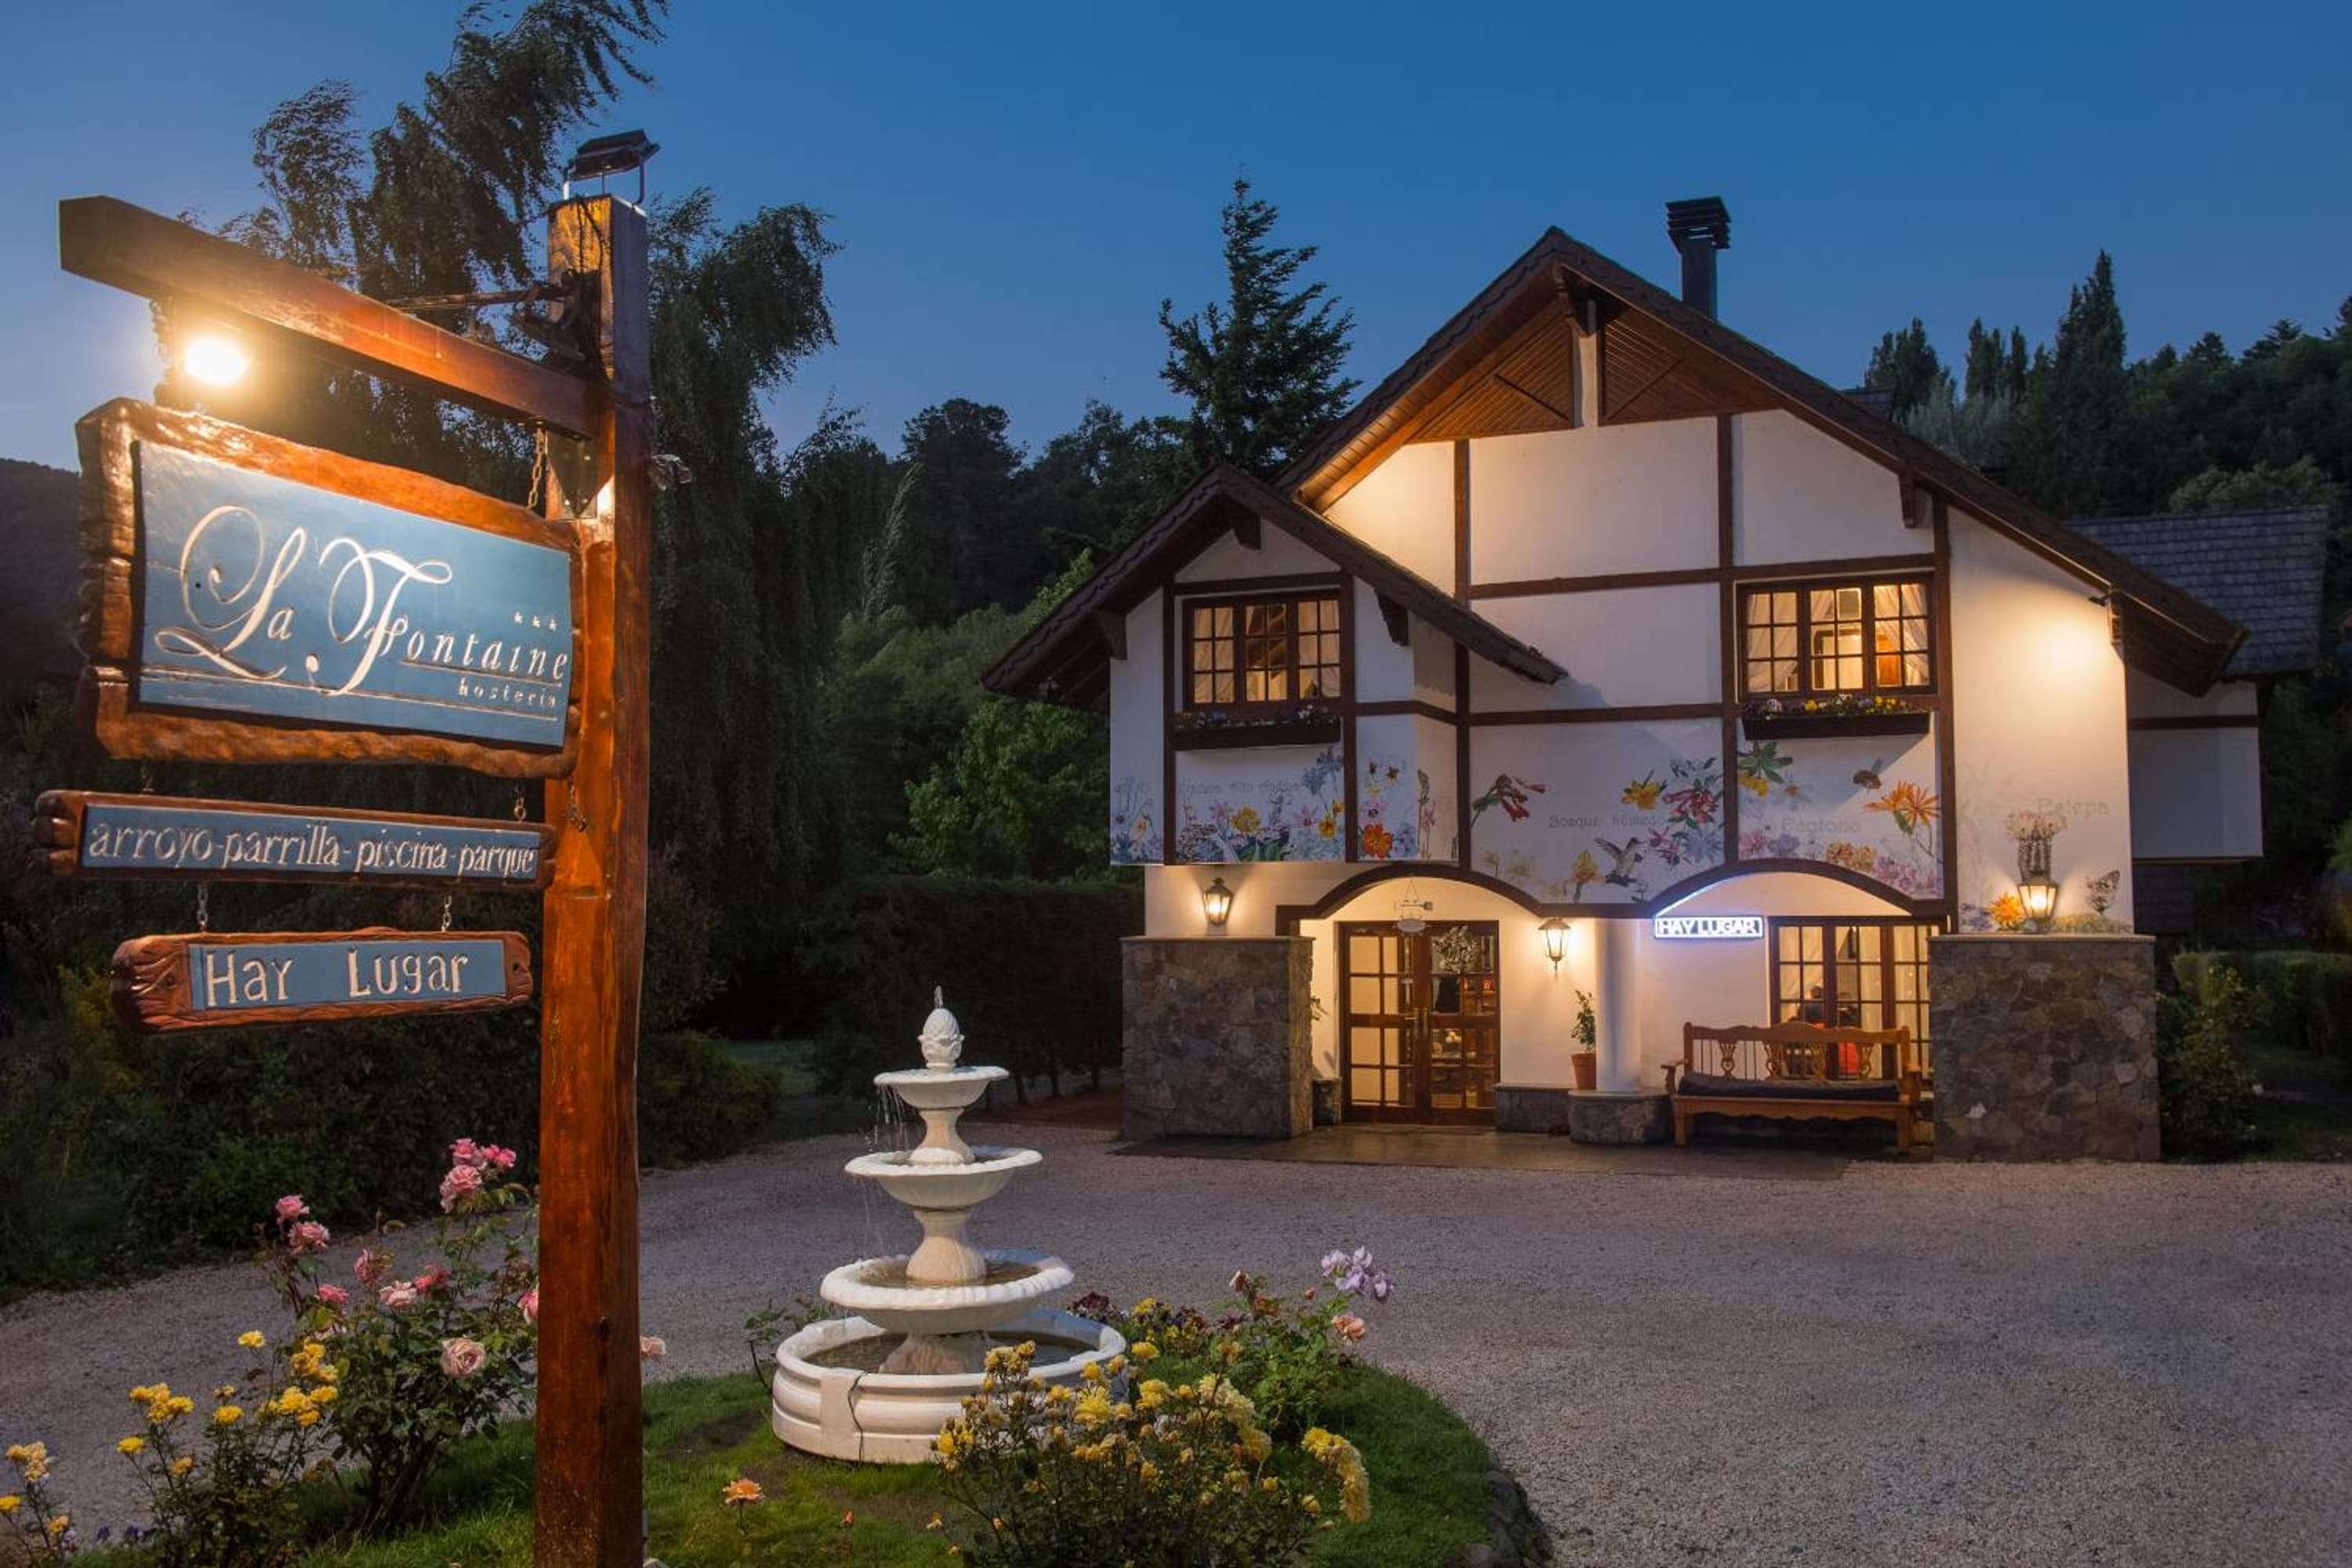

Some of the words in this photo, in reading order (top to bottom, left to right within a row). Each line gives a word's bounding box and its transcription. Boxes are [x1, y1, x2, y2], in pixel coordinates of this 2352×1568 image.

[1658, 919, 1695, 935] HAY
[1697, 919, 1759, 935] LUGAR
[347, 947, 469, 998] Lugar
